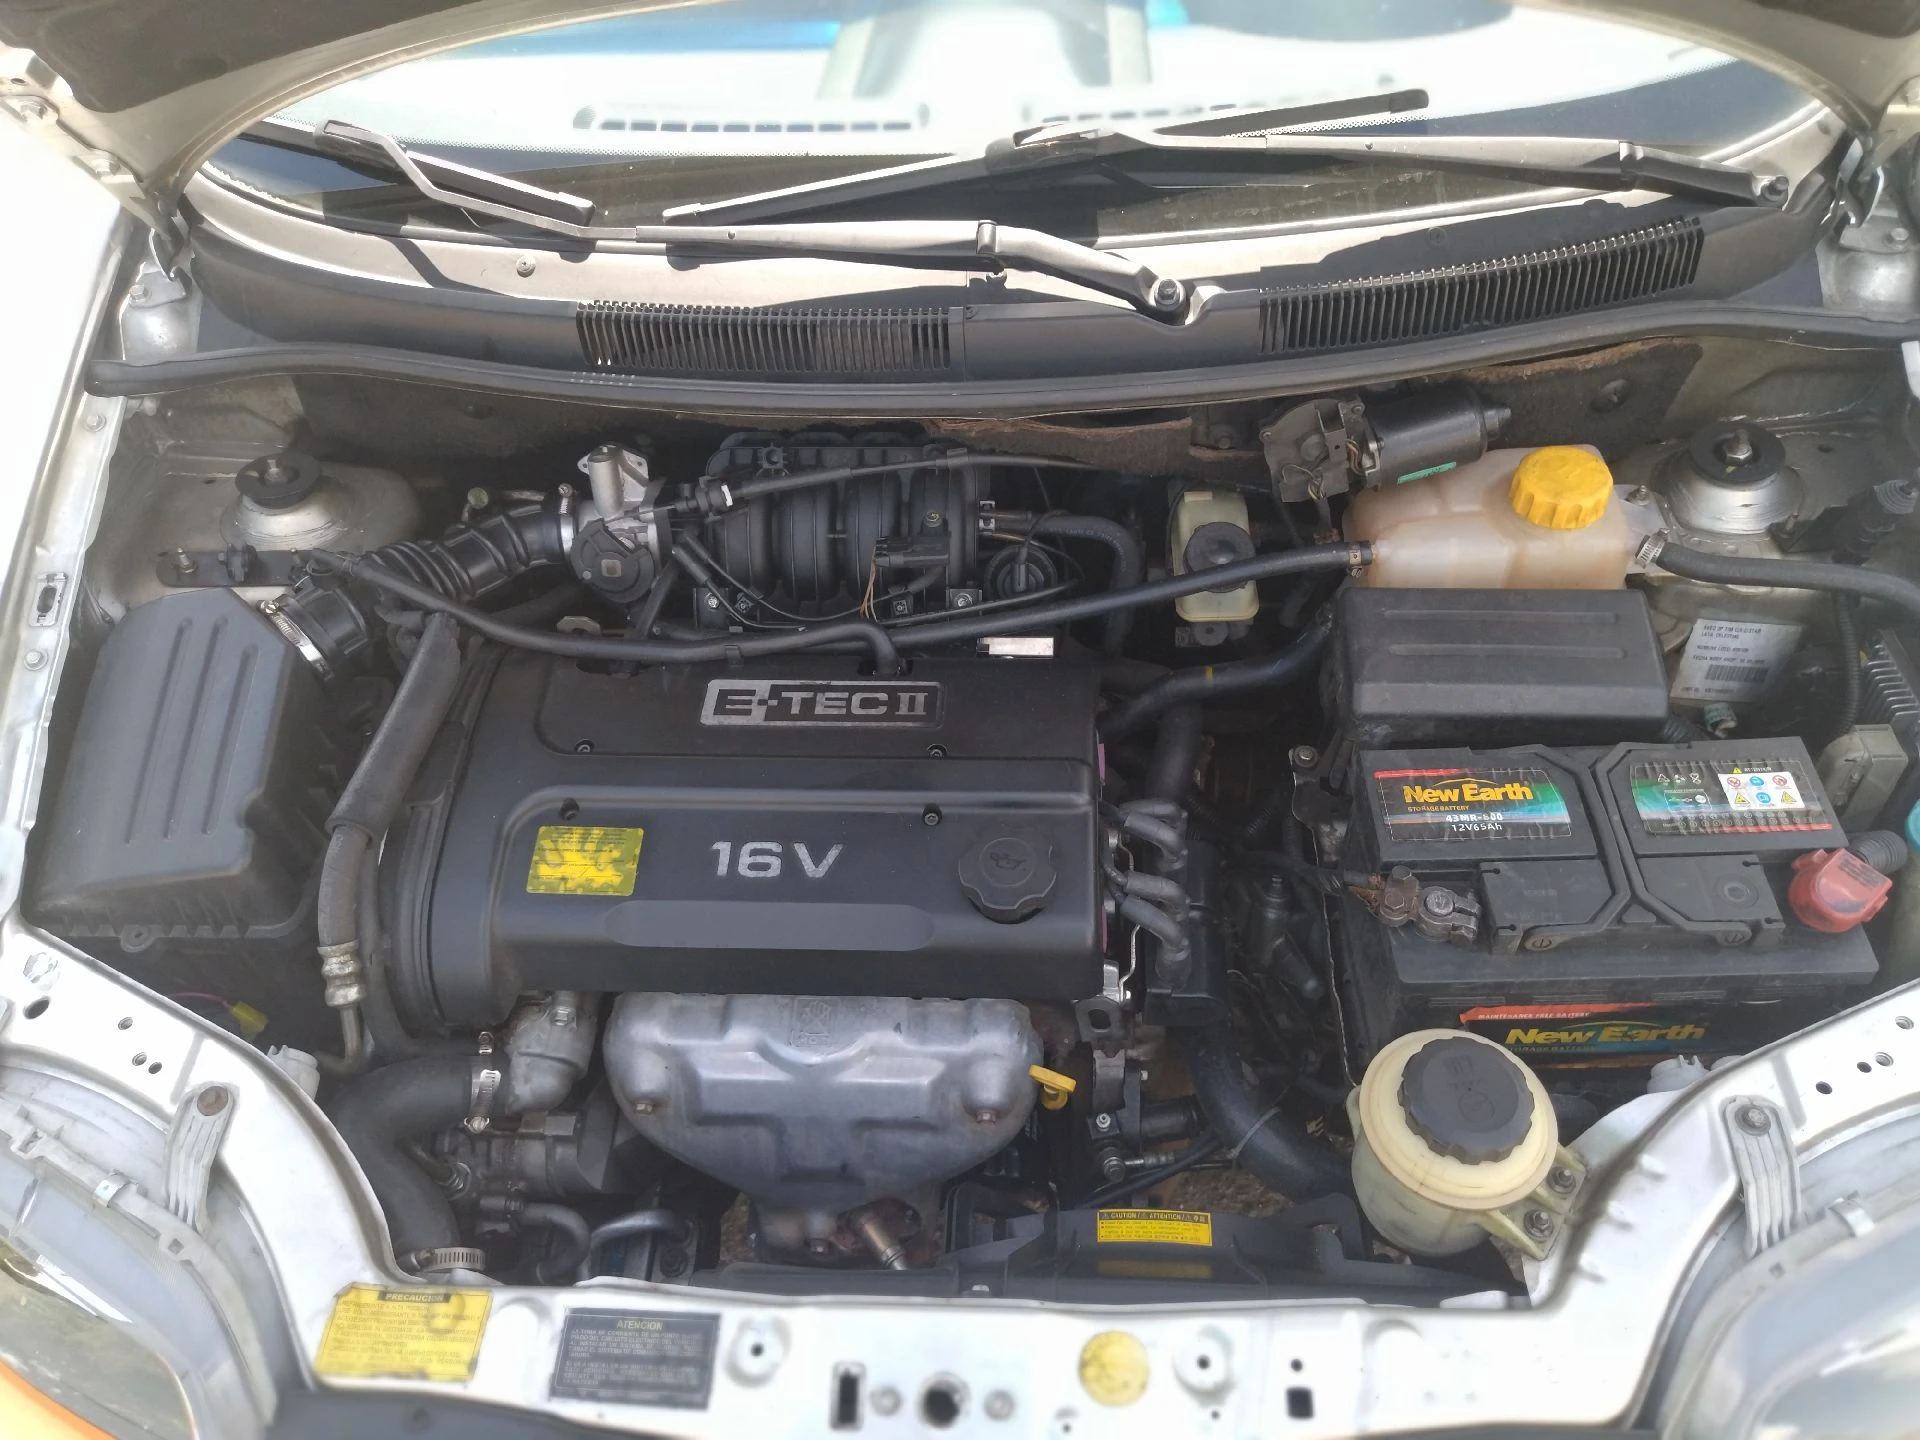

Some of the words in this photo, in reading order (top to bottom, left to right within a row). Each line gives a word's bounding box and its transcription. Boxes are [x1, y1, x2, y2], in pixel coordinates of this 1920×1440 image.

[1402, 785, 1460, 803] New
[1461, 782, 1534, 802] Earth
[1451, 822, 1503, 832] 12V65Ah
[1504, 1028, 1597, 1045] New
[1597, 1023, 1705, 1043] Earth
